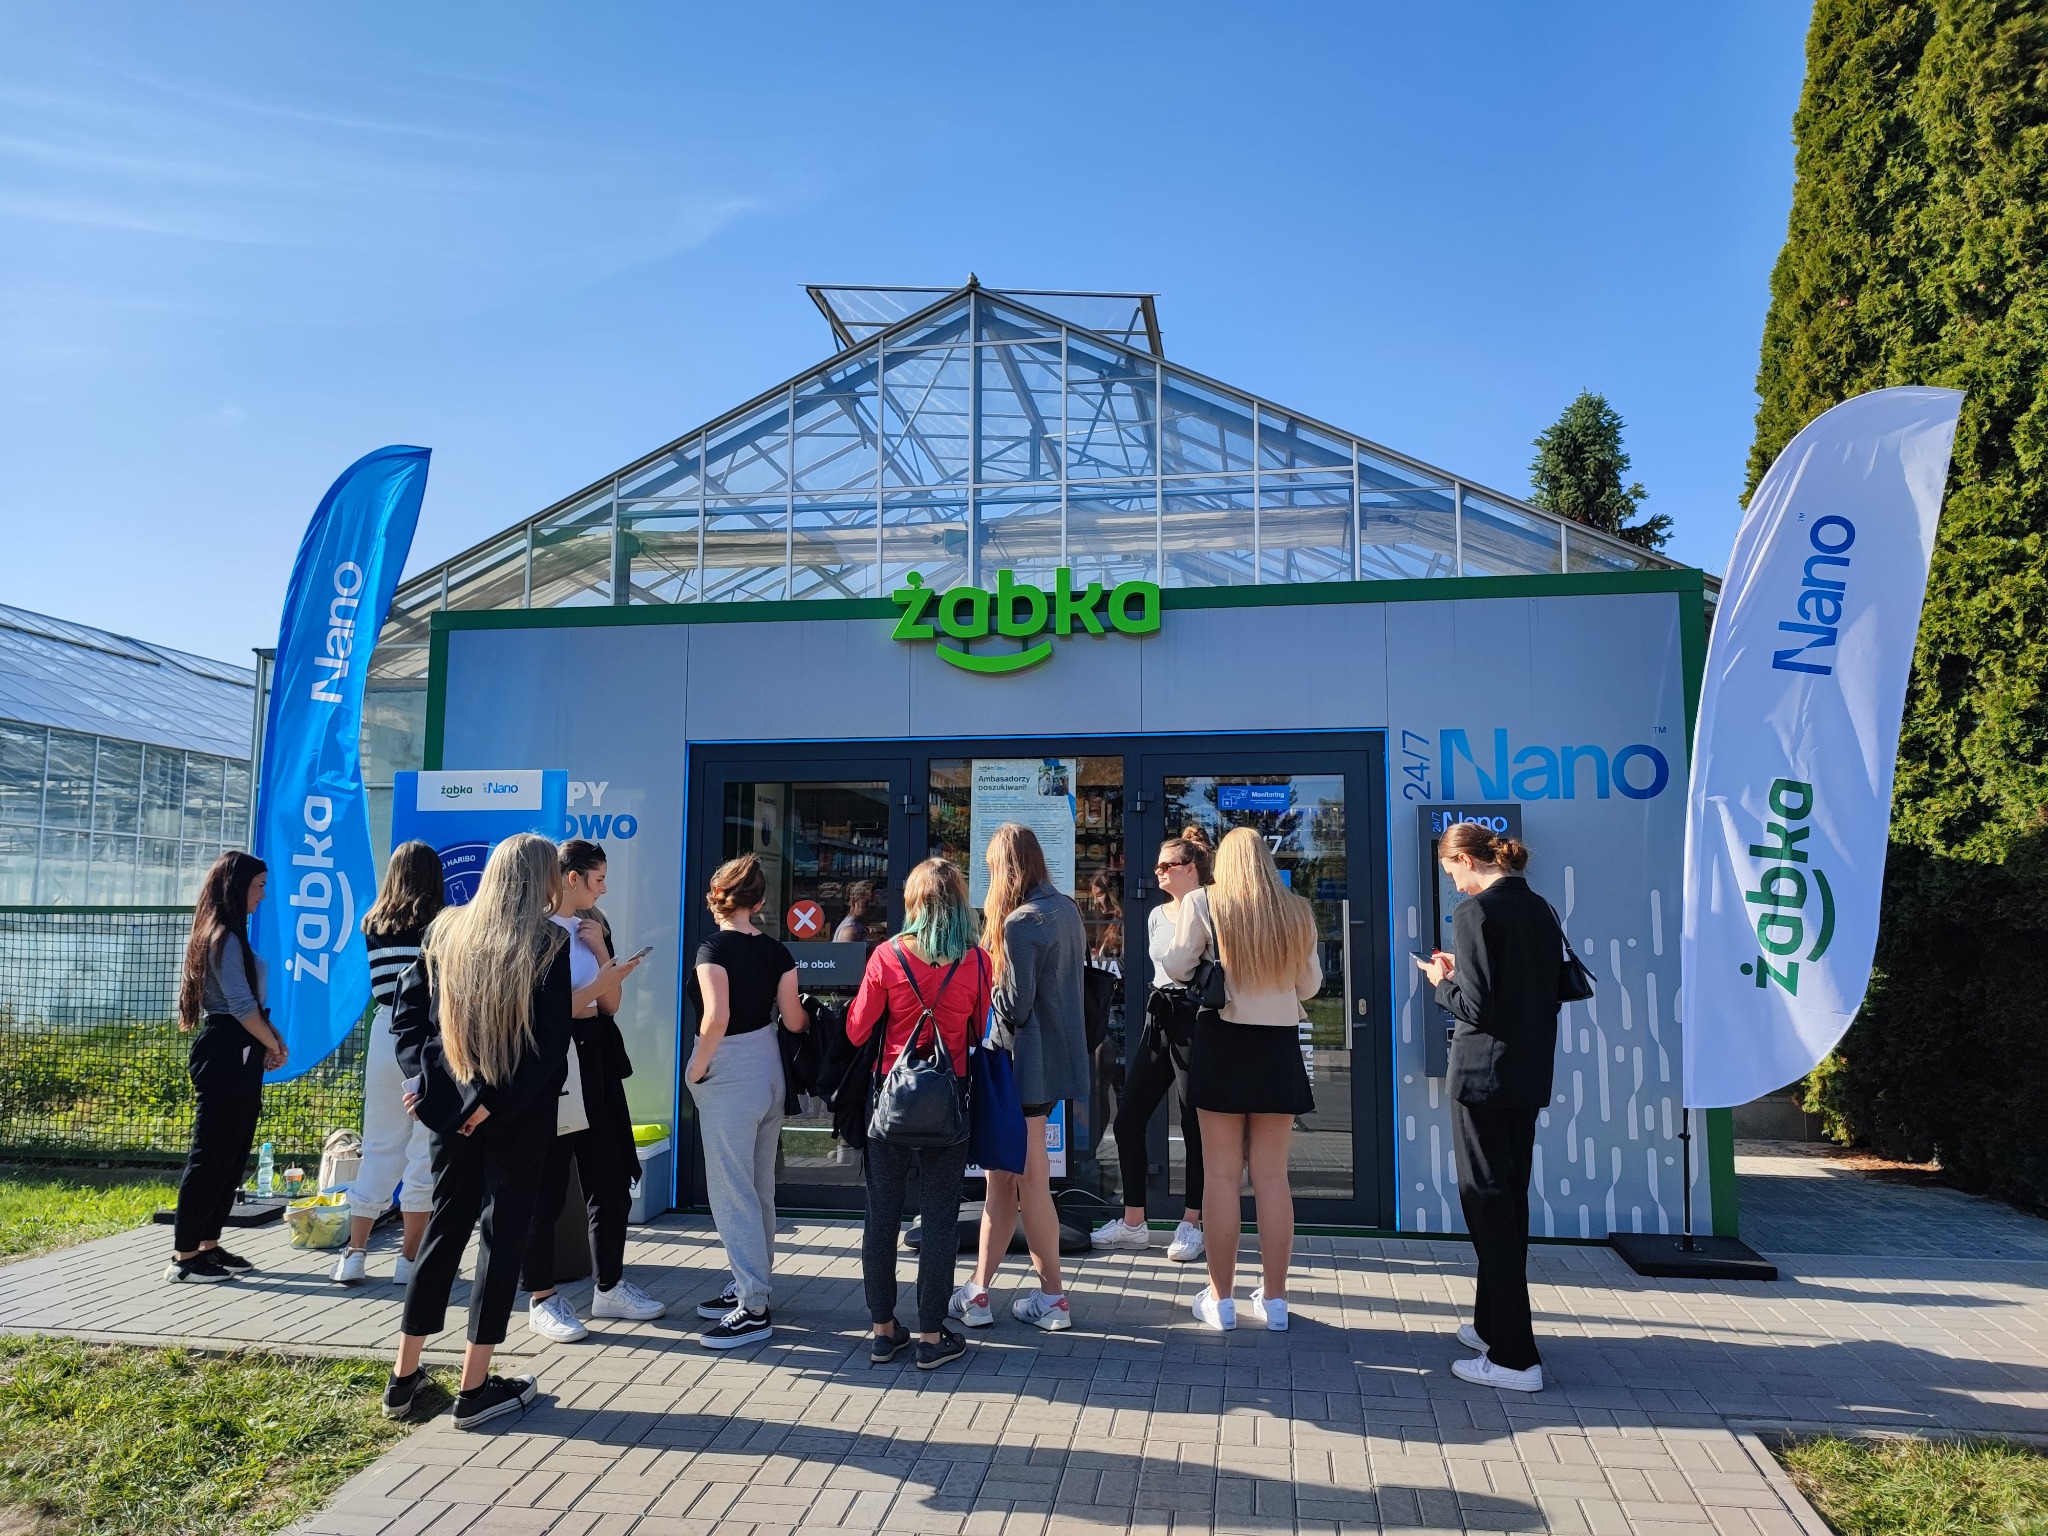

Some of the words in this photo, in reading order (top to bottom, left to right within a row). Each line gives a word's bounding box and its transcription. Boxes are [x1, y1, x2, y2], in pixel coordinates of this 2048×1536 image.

[891, 567, 1161, 640] żabka
[1771, 514, 1856, 676] Nano
[310, 561, 363, 704] Nano
[441, 784, 473, 794] żabka
[488, 782, 519, 794] Nano
[978, 775, 1031, 784] Ambasadorzy
[978, 784, 1028, 792] poszukiwani!
[1401, 729, 1432, 801] 24/7
[1439, 728, 1670, 801] Nano
[1431, 811, 1442, 833] 24/7
[447, 854, 476, 867] HARIBO
[285, 795, 334, 985] żabka
[1739, 778, 1814, 997] żabka
[810, 960, 836, 969] obok
